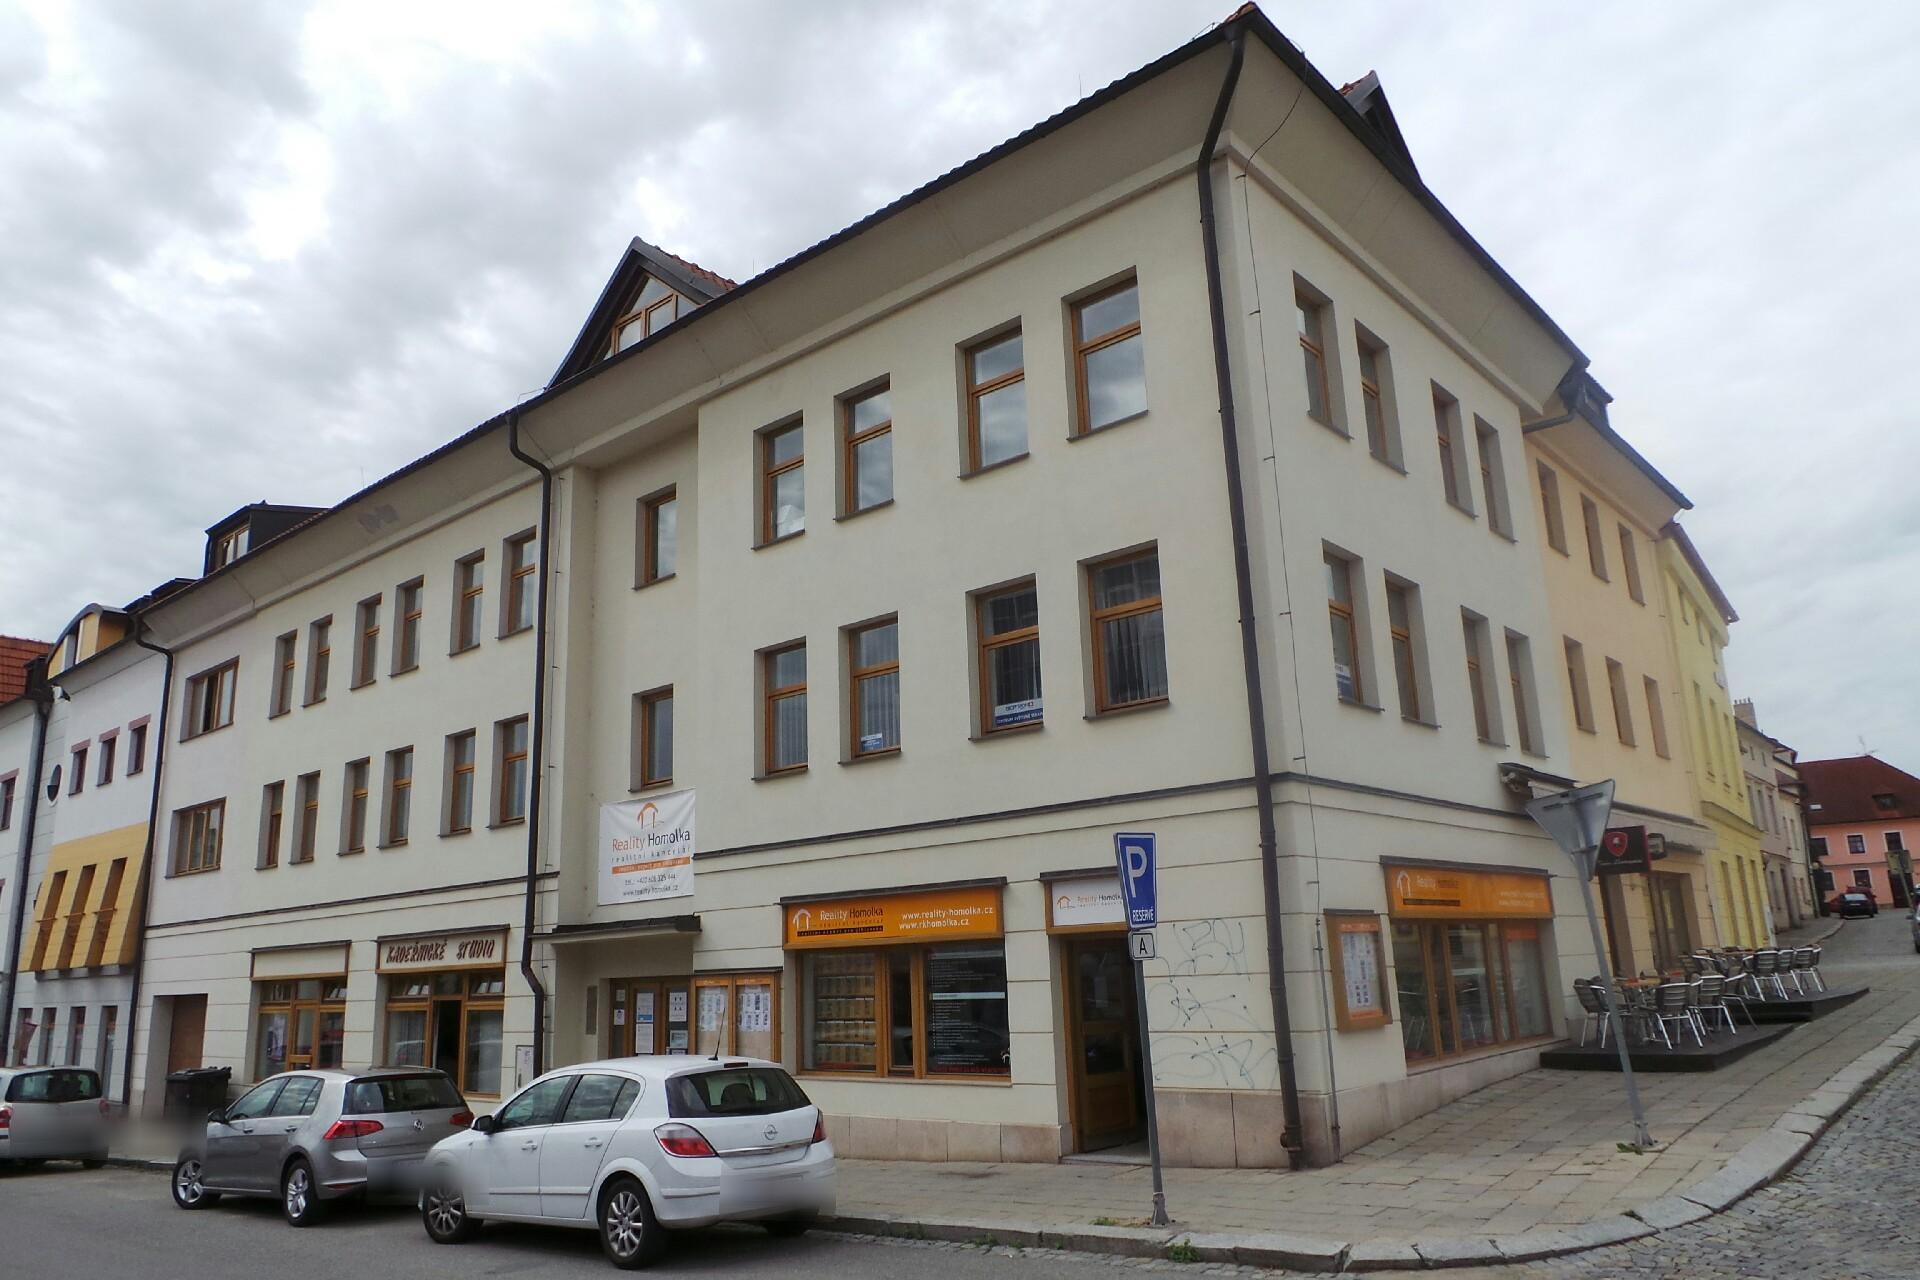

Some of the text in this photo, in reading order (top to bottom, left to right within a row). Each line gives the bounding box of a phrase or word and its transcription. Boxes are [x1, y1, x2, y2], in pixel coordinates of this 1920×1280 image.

[612, 827, 690, 852] Reality Homolka
[1126, 845, 1148, 898] P
[820, 907, 883, 921] Reality Homolka
[902, 906, 993, 920] www.reality-homolka.cz
[456, 939, 495, 961] STUDIO
[1139, 937, 1148, 955] A
